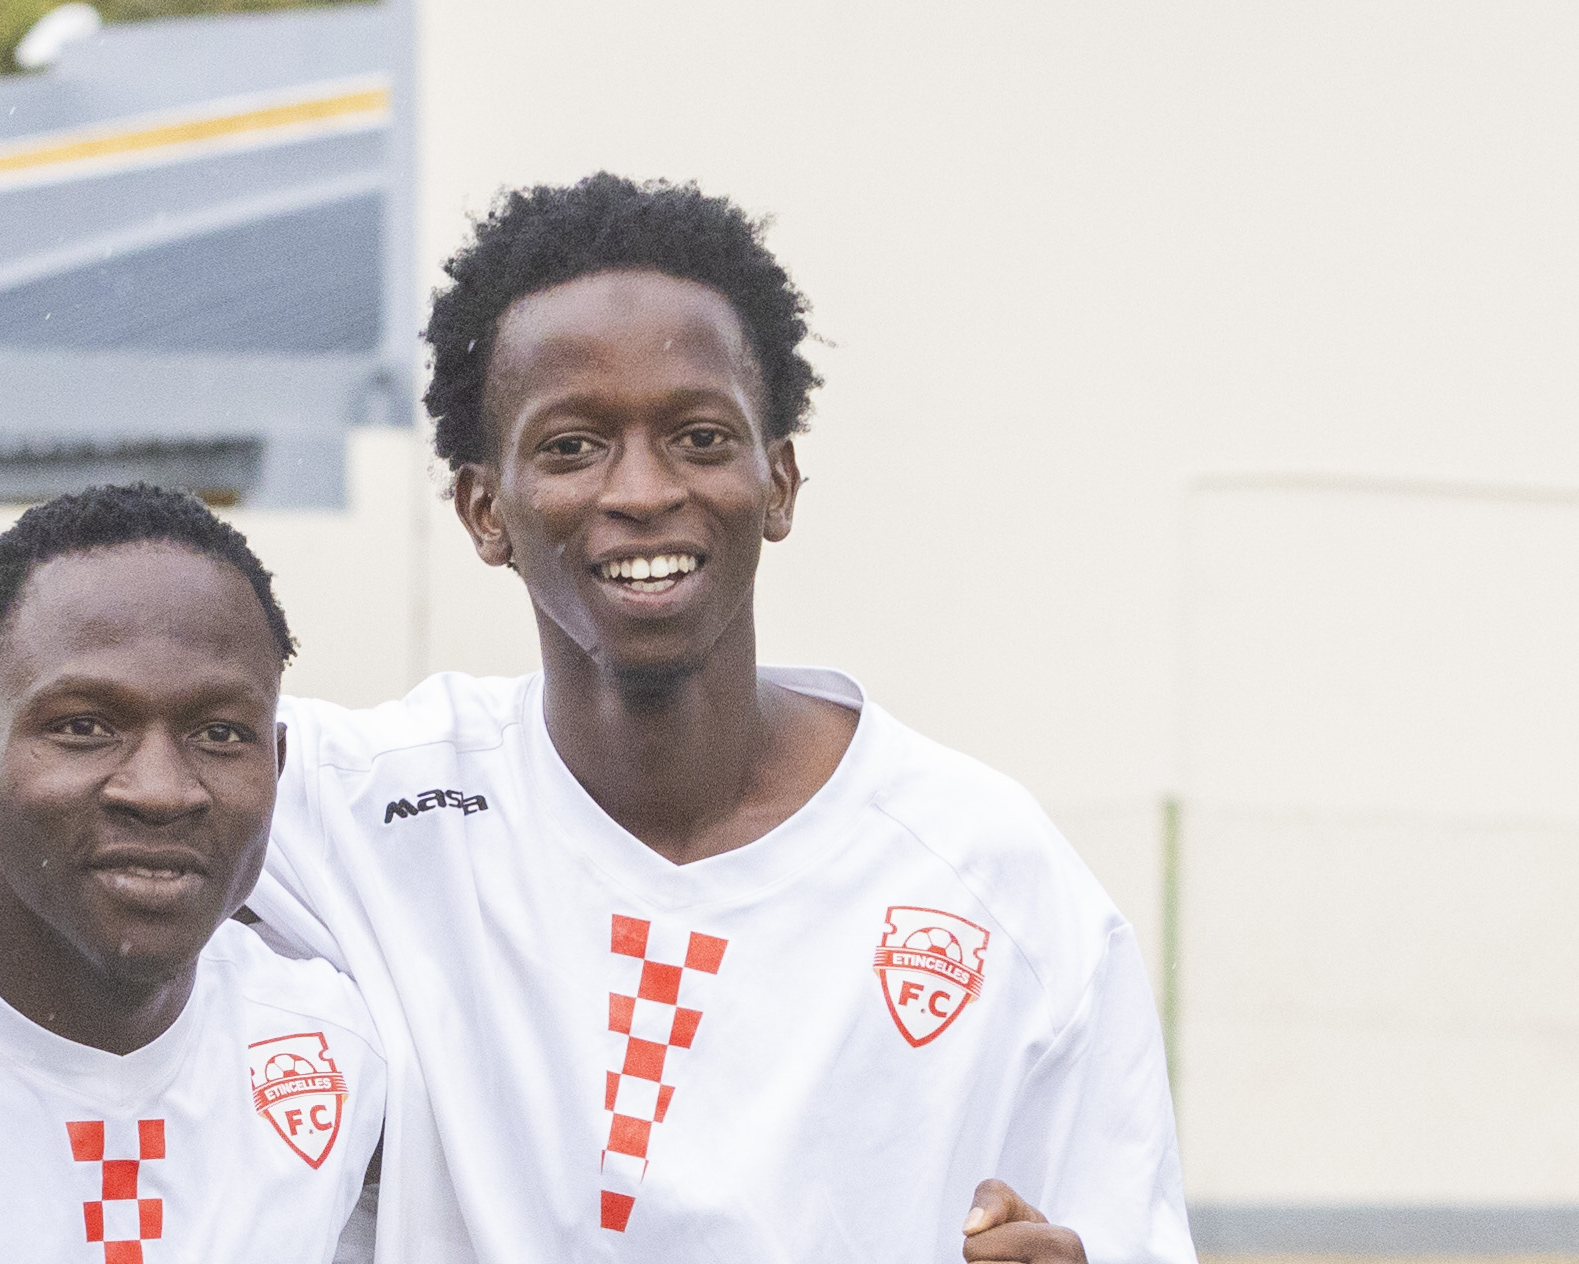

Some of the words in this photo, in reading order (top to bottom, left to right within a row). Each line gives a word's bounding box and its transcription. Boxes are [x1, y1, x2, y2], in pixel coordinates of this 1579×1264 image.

[892, 953, 971, 985] ETINCELLES
[898, 980, 951, 1018] F.C
[264, 1077, 332, 1101] ETINCELLES
[284, 1104, 333, 1136] F.C
